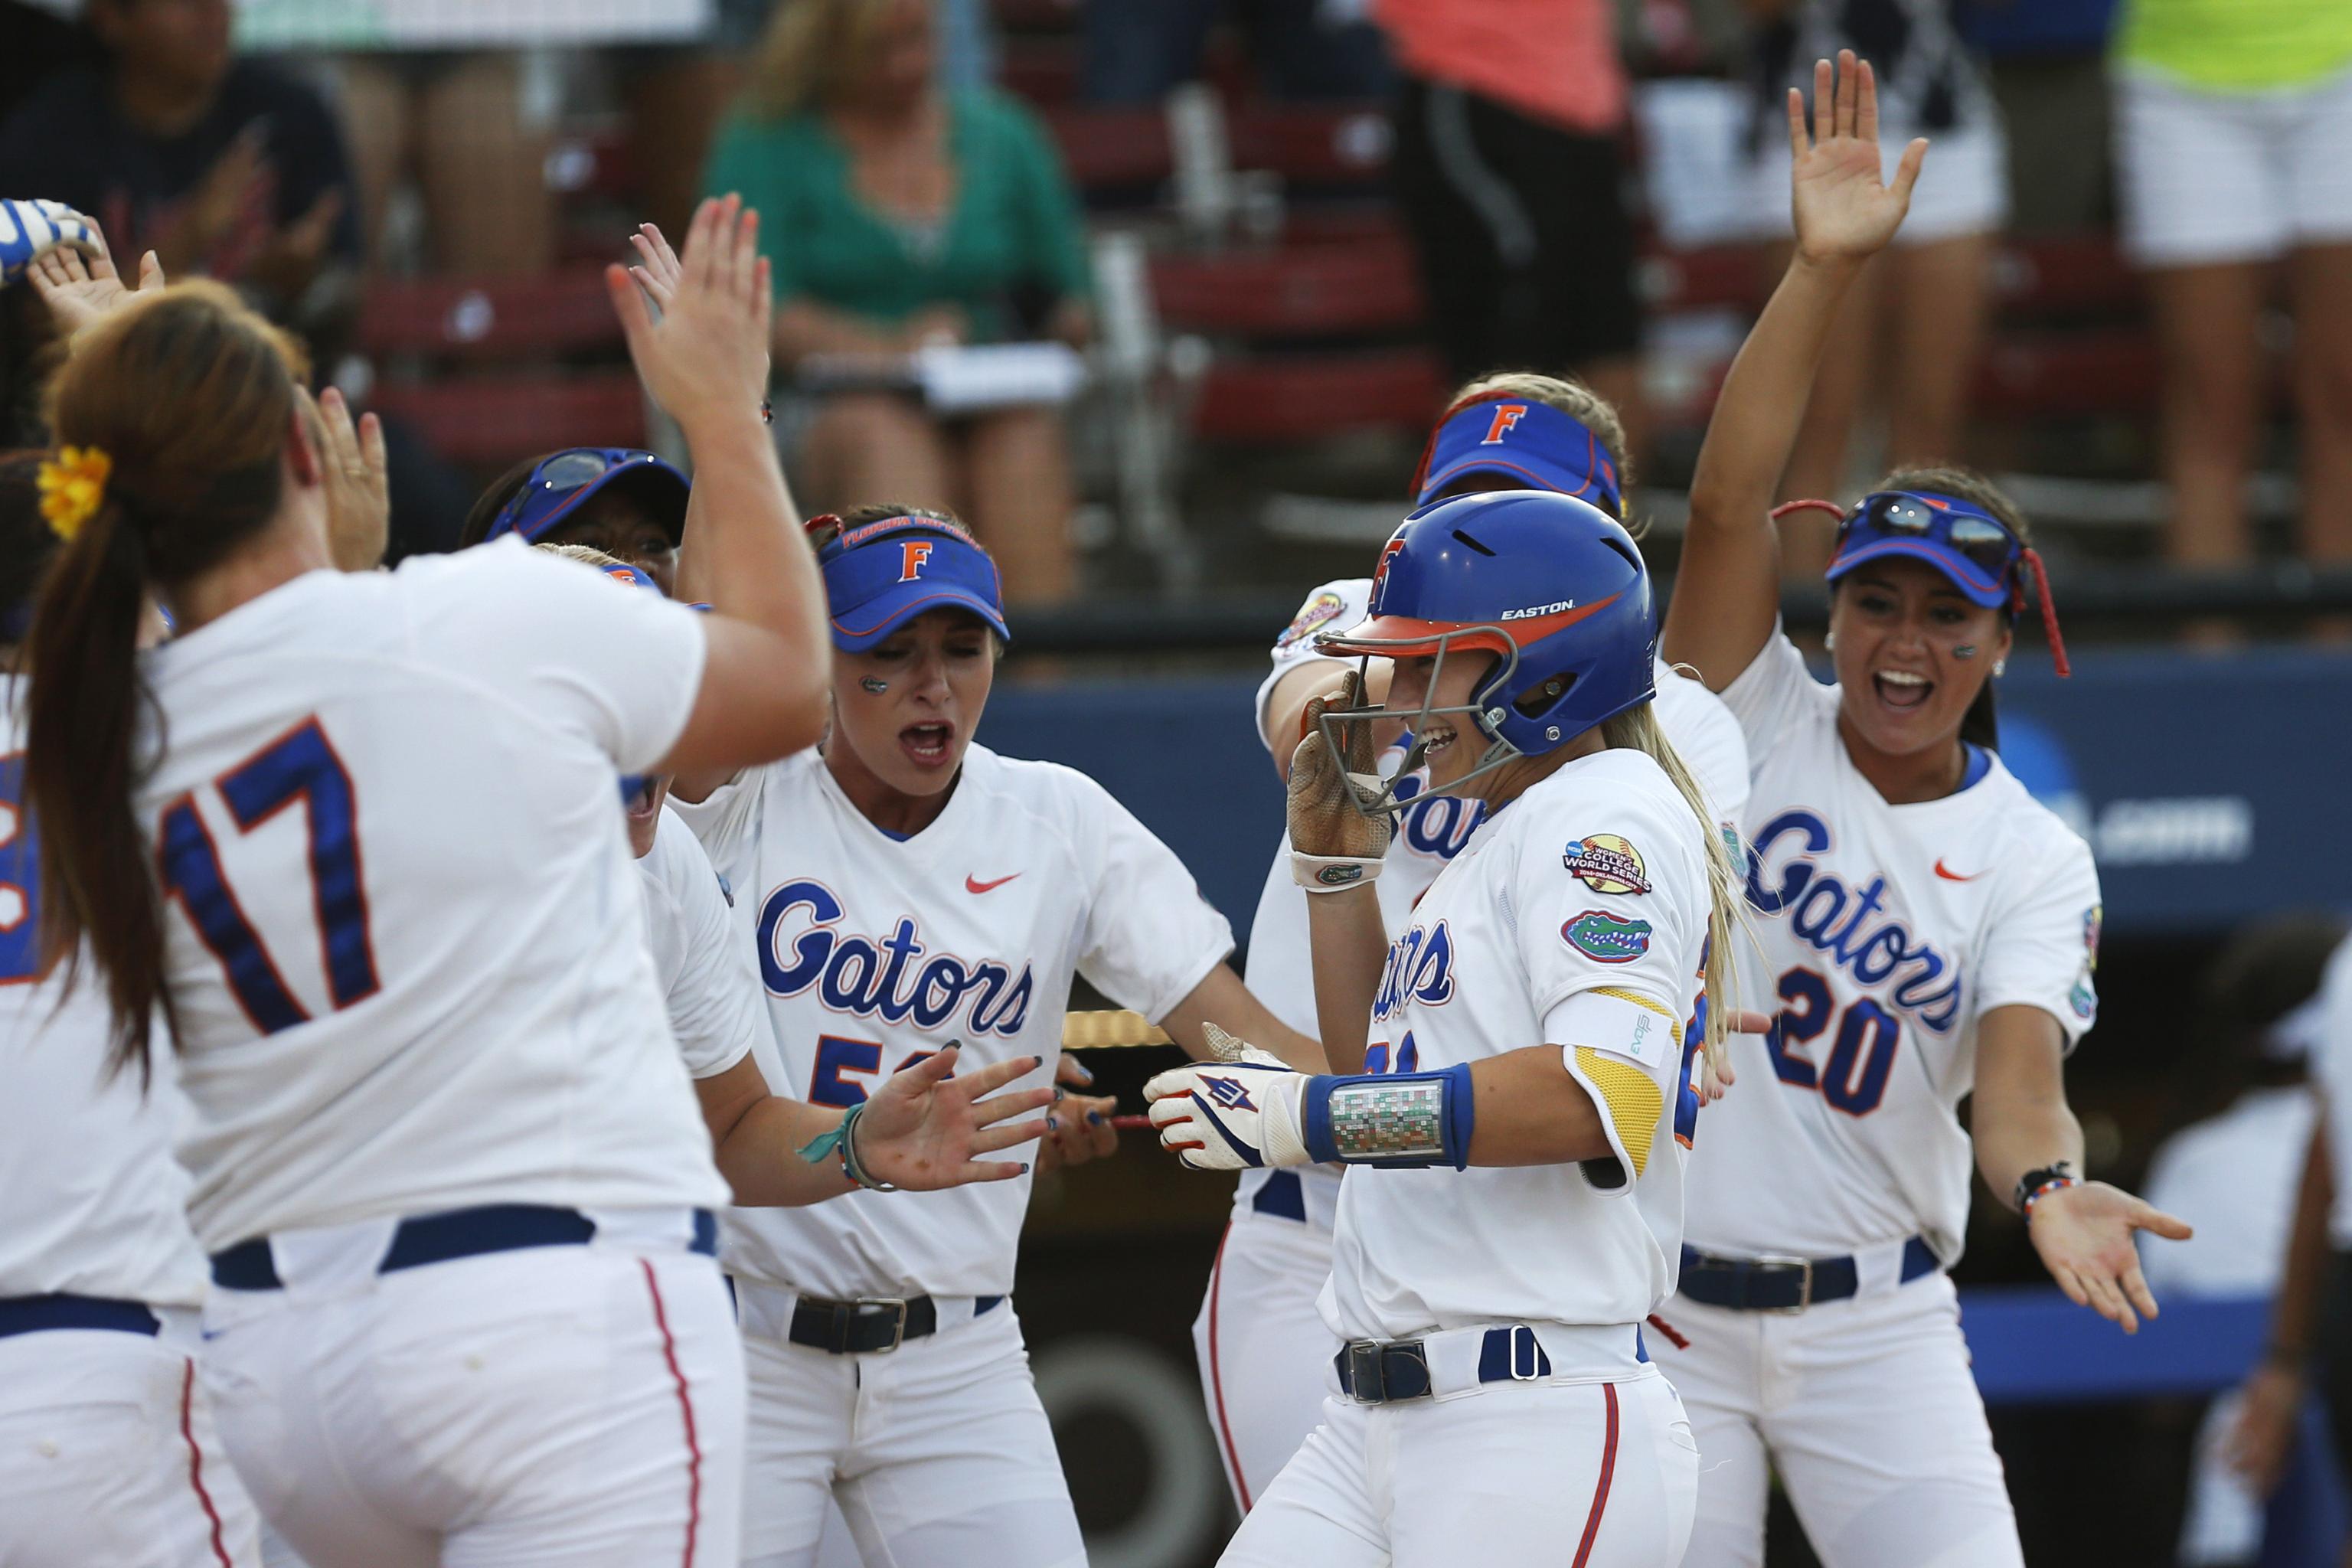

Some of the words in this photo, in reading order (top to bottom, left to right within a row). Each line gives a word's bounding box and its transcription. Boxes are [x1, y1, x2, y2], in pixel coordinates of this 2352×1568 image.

[1480, 404, 1528, 446] F
[897, 541, 933, 583] F
[1501, 599, 1574, 620] EASTON
[158, 712, 382, 1037] 17
[1564, 856, 1610, 871] WORLD
[1612, 867, 1651, 891] SERIES
[1584, 851, 1639, 875] COLLEGE
[1595, 847, 1633, 864] WOMEN'S
[1743, 805, 1963, 1040] Gators
[756, 876, 1034, 1039] Gators
[1765, 964, 1900, 1118] 20
